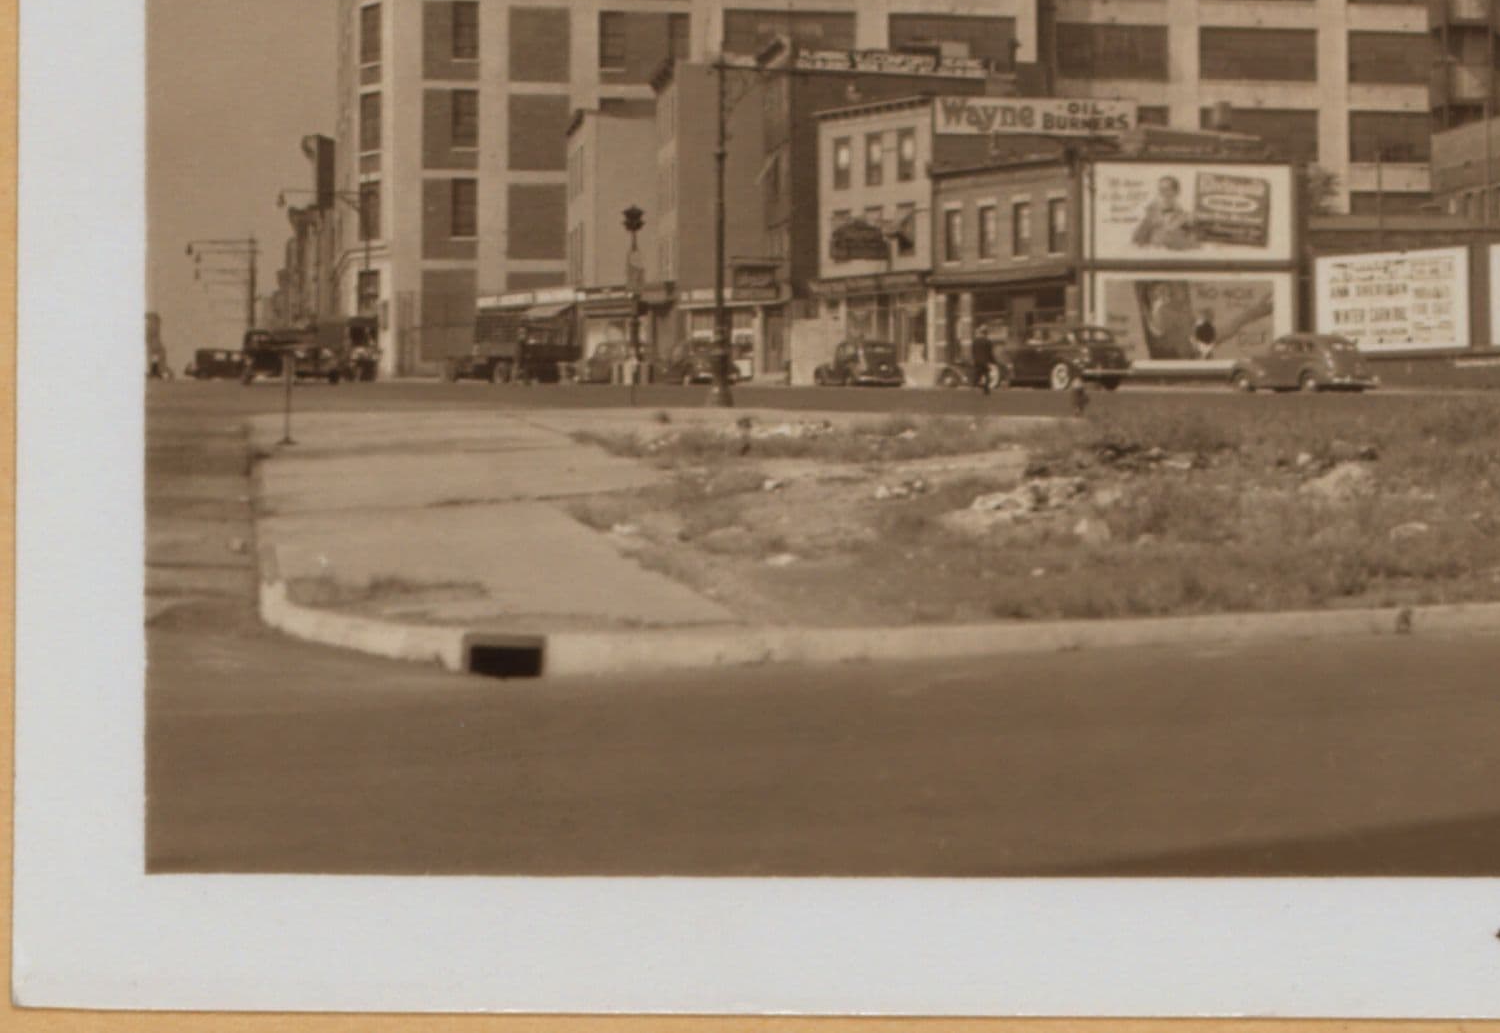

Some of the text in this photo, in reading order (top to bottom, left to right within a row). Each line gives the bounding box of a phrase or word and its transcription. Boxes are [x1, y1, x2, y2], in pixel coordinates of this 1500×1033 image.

[941, 97, 1035, 131] Wayne
[1067, 102, 1104, 115] OIL
[1042, 113, 1128, 130] BURNERS
